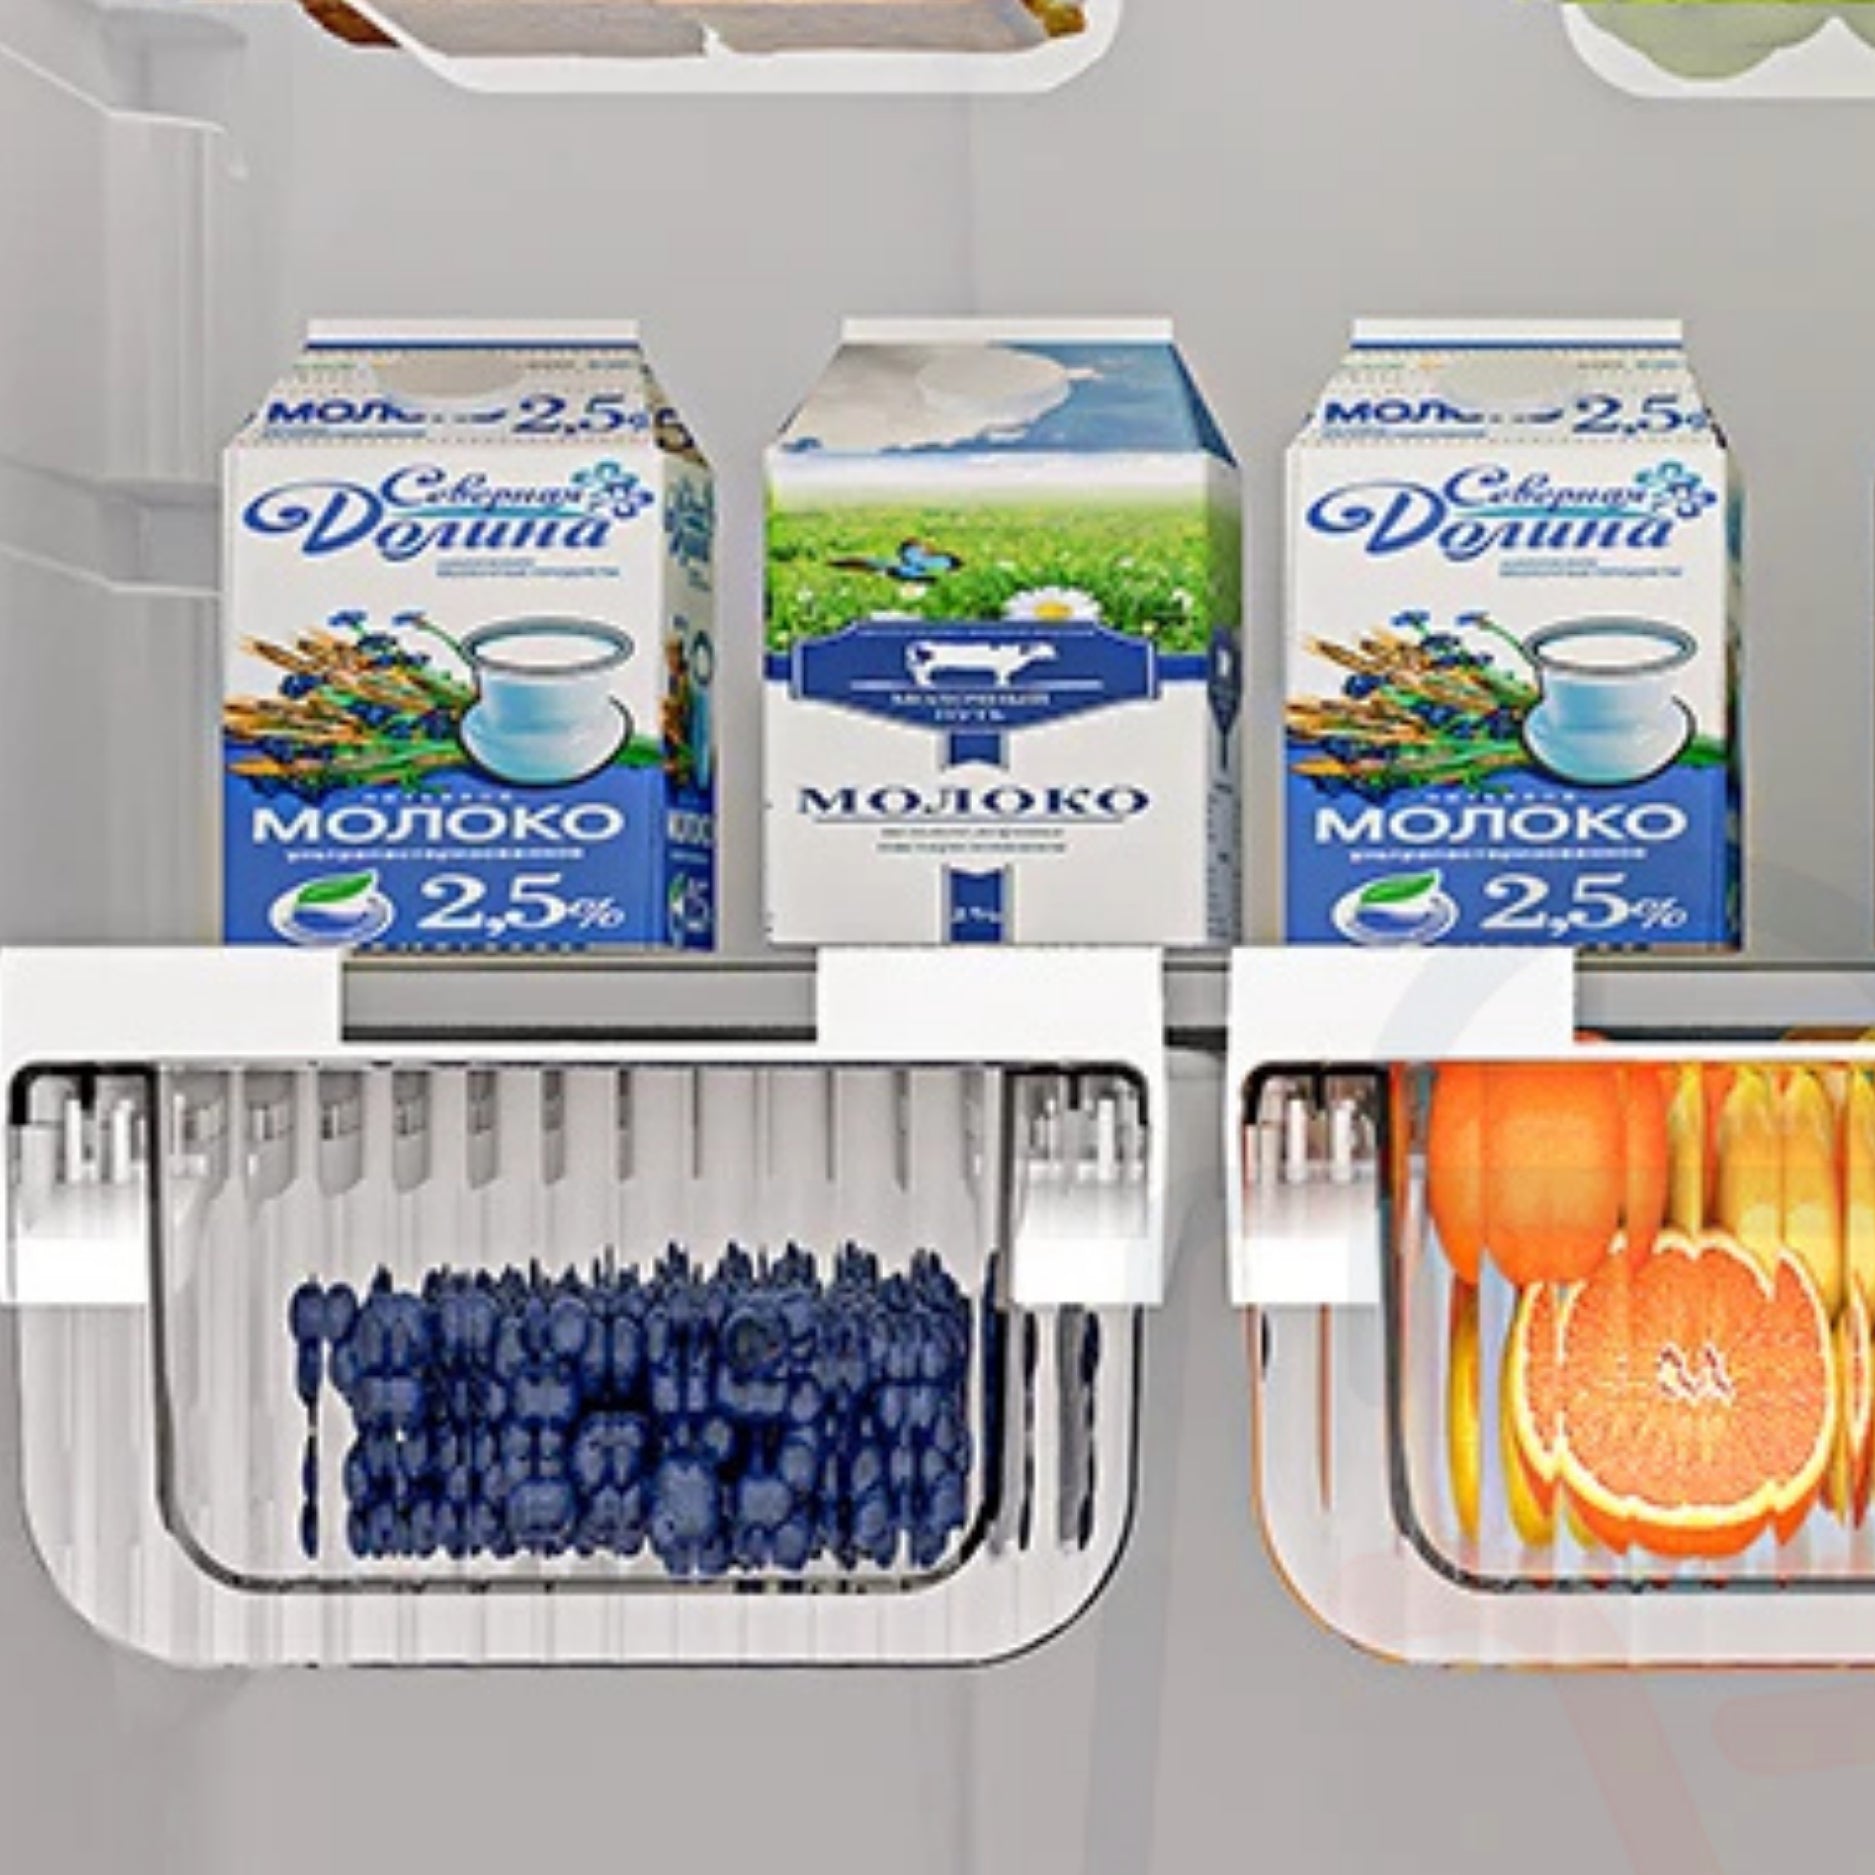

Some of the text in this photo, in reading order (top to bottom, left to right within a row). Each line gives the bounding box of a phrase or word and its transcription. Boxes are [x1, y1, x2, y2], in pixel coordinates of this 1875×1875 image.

[267, 398, 506, 424] МОЛ
[1324, 398, 1564, 423] МОЛ
[243, 481, 611, 562] Долина
[1307, 482, 1674, 561] Долина
[799, 788, 1150, 815] МОЛОКО
[251, 803, 624, 844] МОЛОКО
[1316, 804, 1688, 843] МОЛОКО
[416, 872, 624, 934] 2,5%
[1480, 872, 1687, 936] 2,5%
